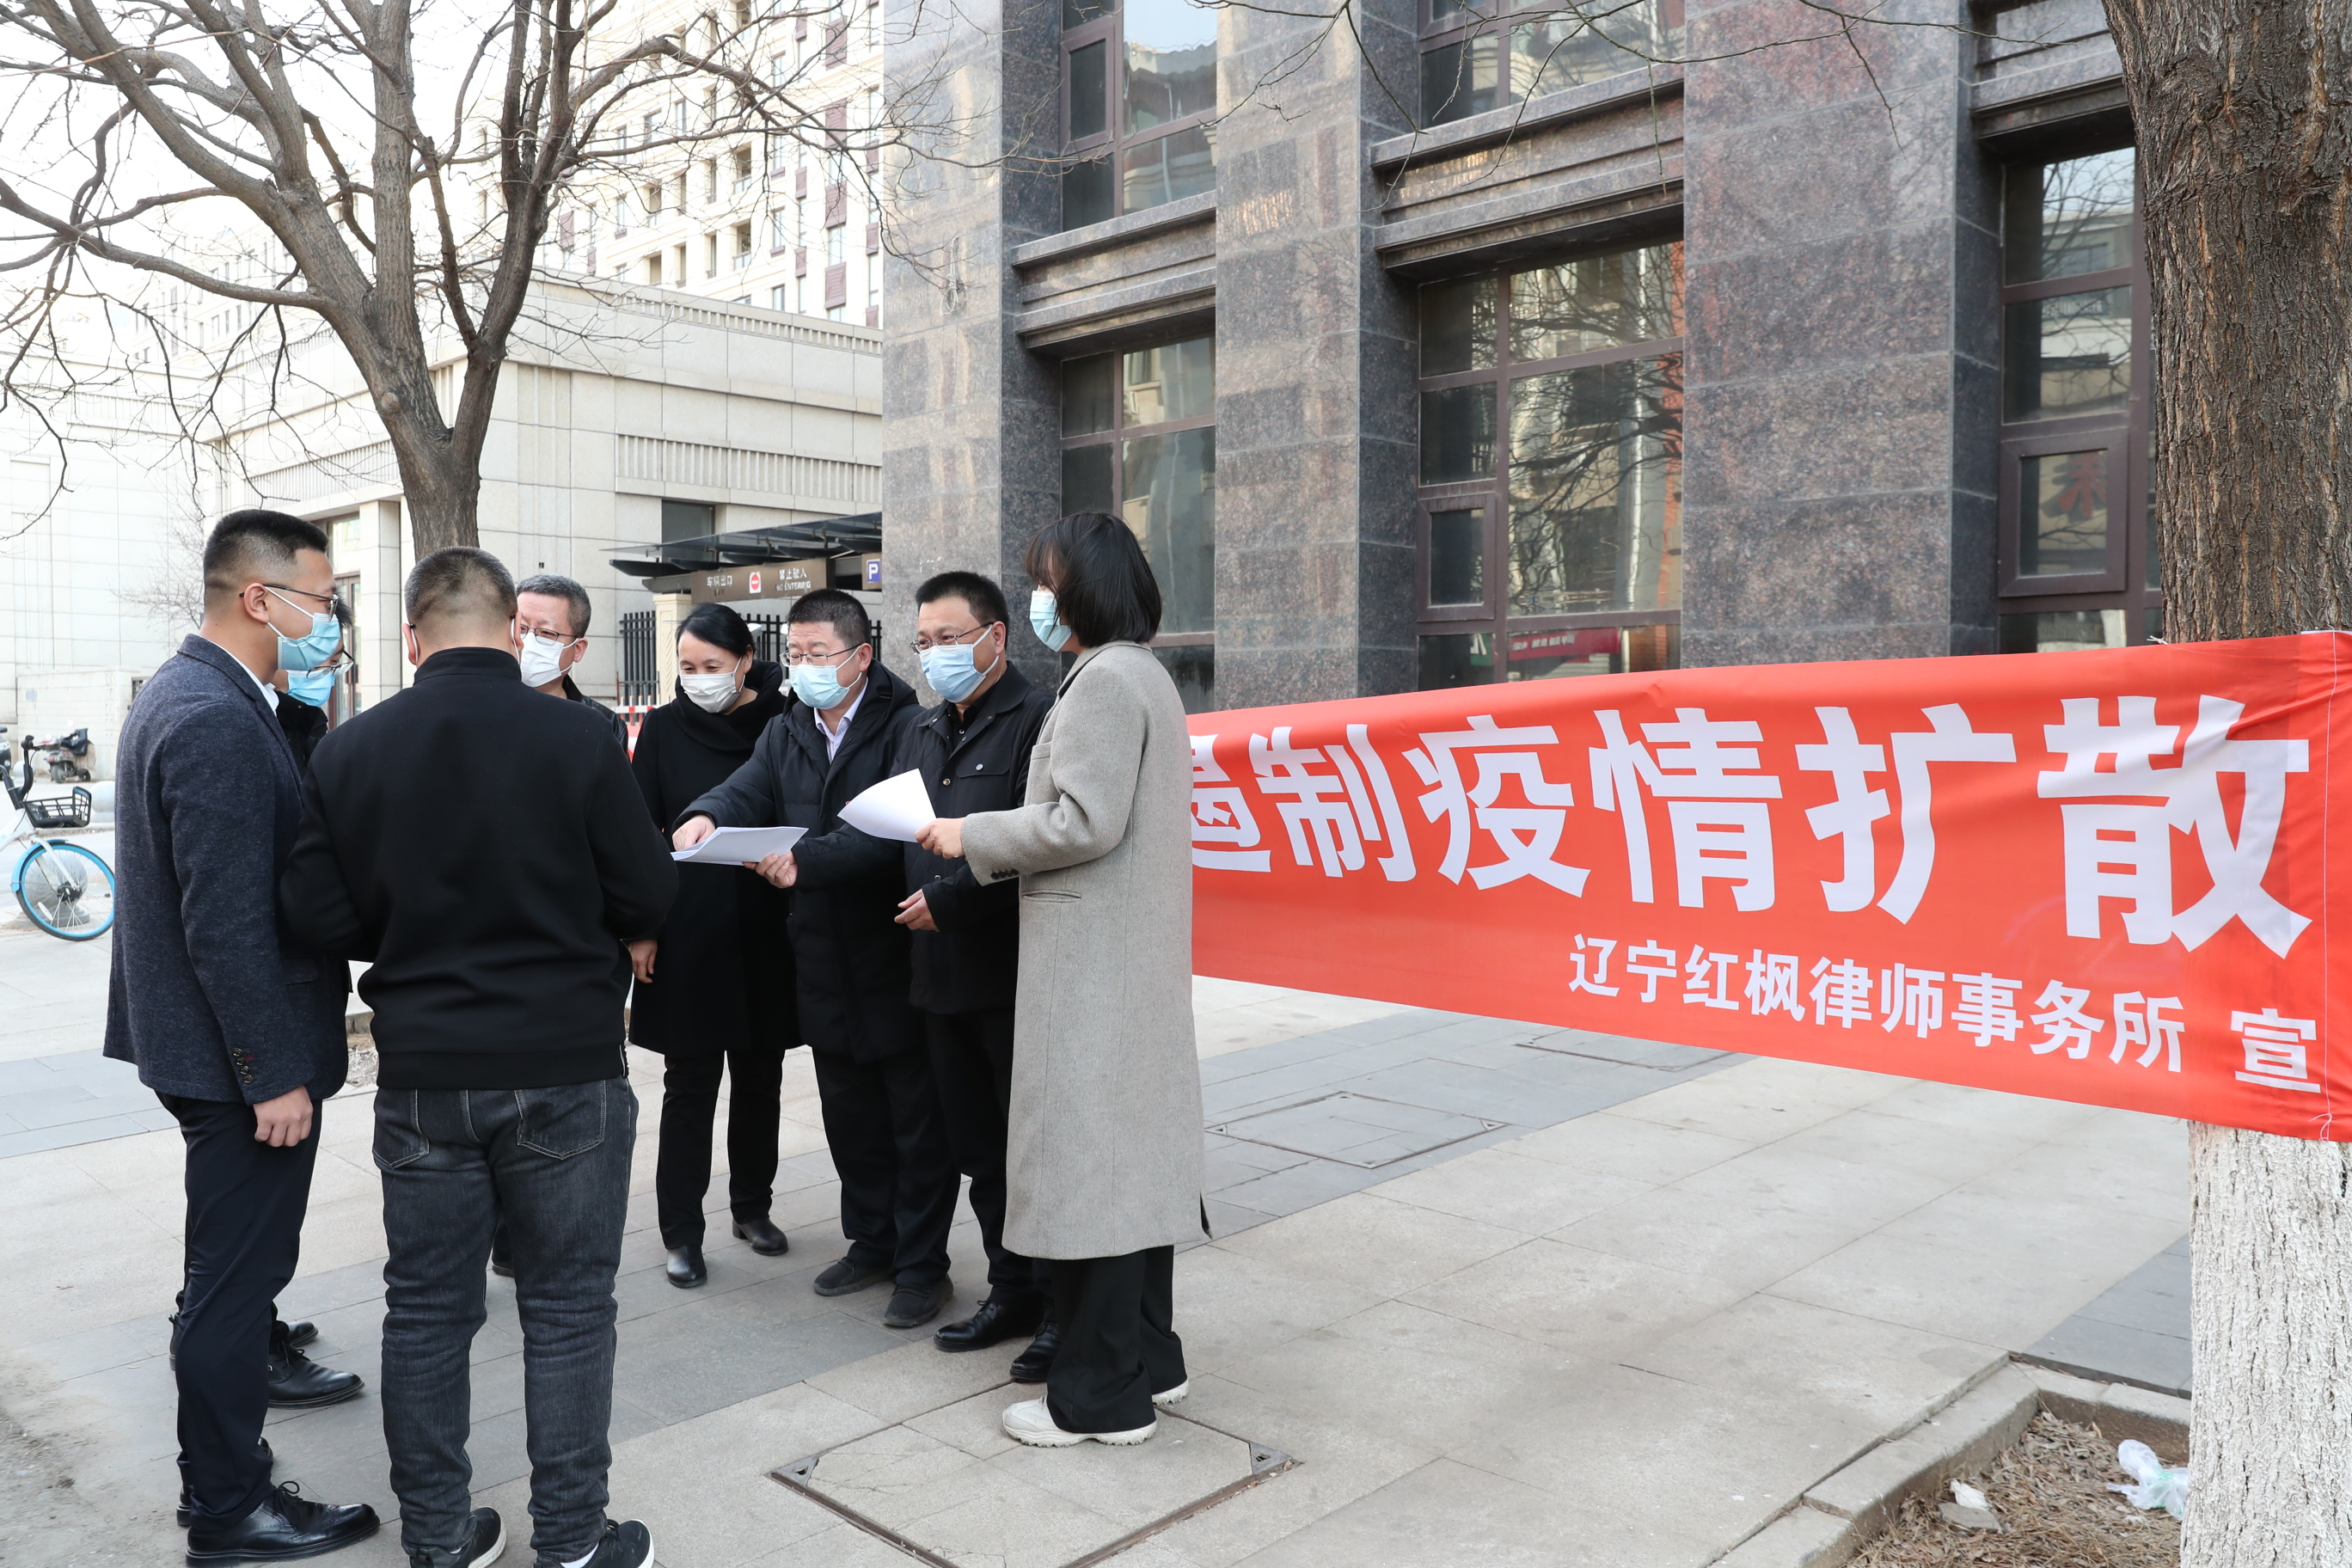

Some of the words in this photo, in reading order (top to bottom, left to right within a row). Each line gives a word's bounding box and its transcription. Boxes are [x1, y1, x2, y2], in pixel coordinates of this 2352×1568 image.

[779, 567, 807, 580] 禁止驶入
[868, 563, 879, 580] P
[707, 574, 732, 587] 车辆出口
[1567, 933, 2186, 1073] 辽宁红枫律师事务所
[2230, 1008, 2322, 1093] 宣
